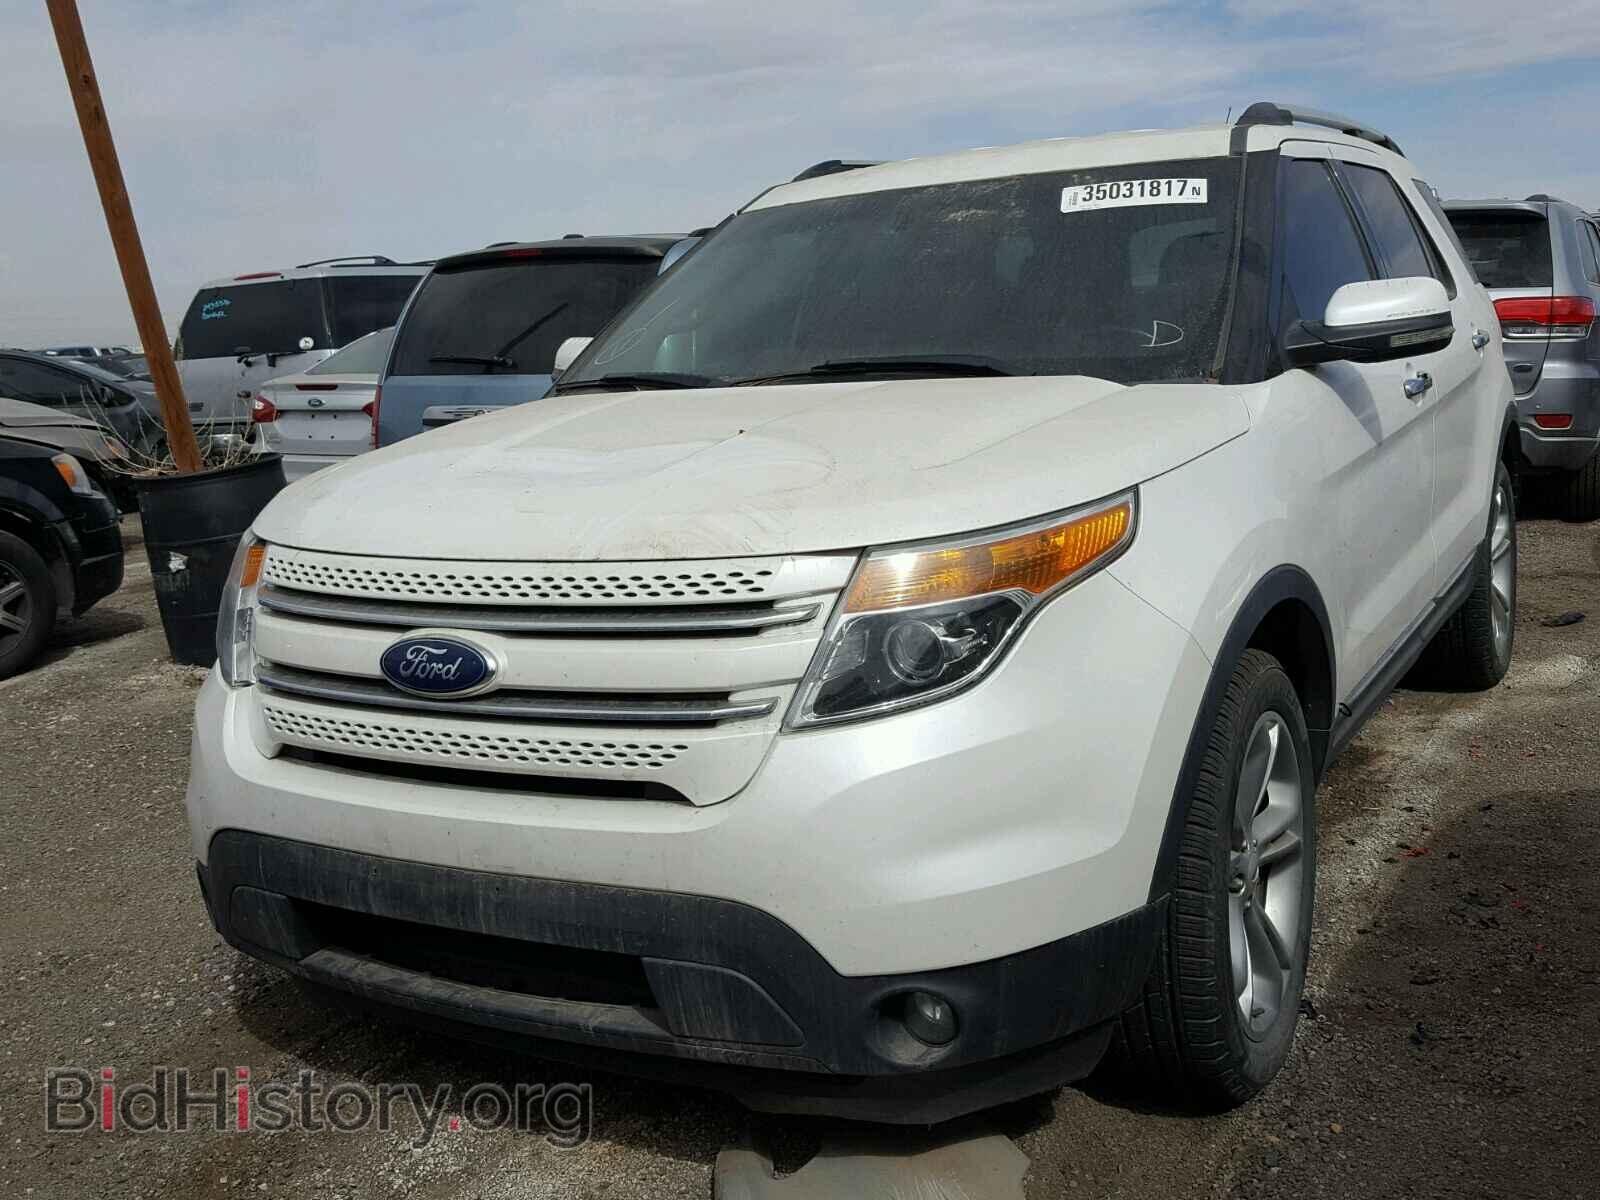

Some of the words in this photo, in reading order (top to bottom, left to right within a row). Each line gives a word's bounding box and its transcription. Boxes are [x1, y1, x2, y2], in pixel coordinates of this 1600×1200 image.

[1082, 179, 1188, 202] 35031817
[1191, 186, 1201, 196] N
[399, 645, 463, 680] Ford
